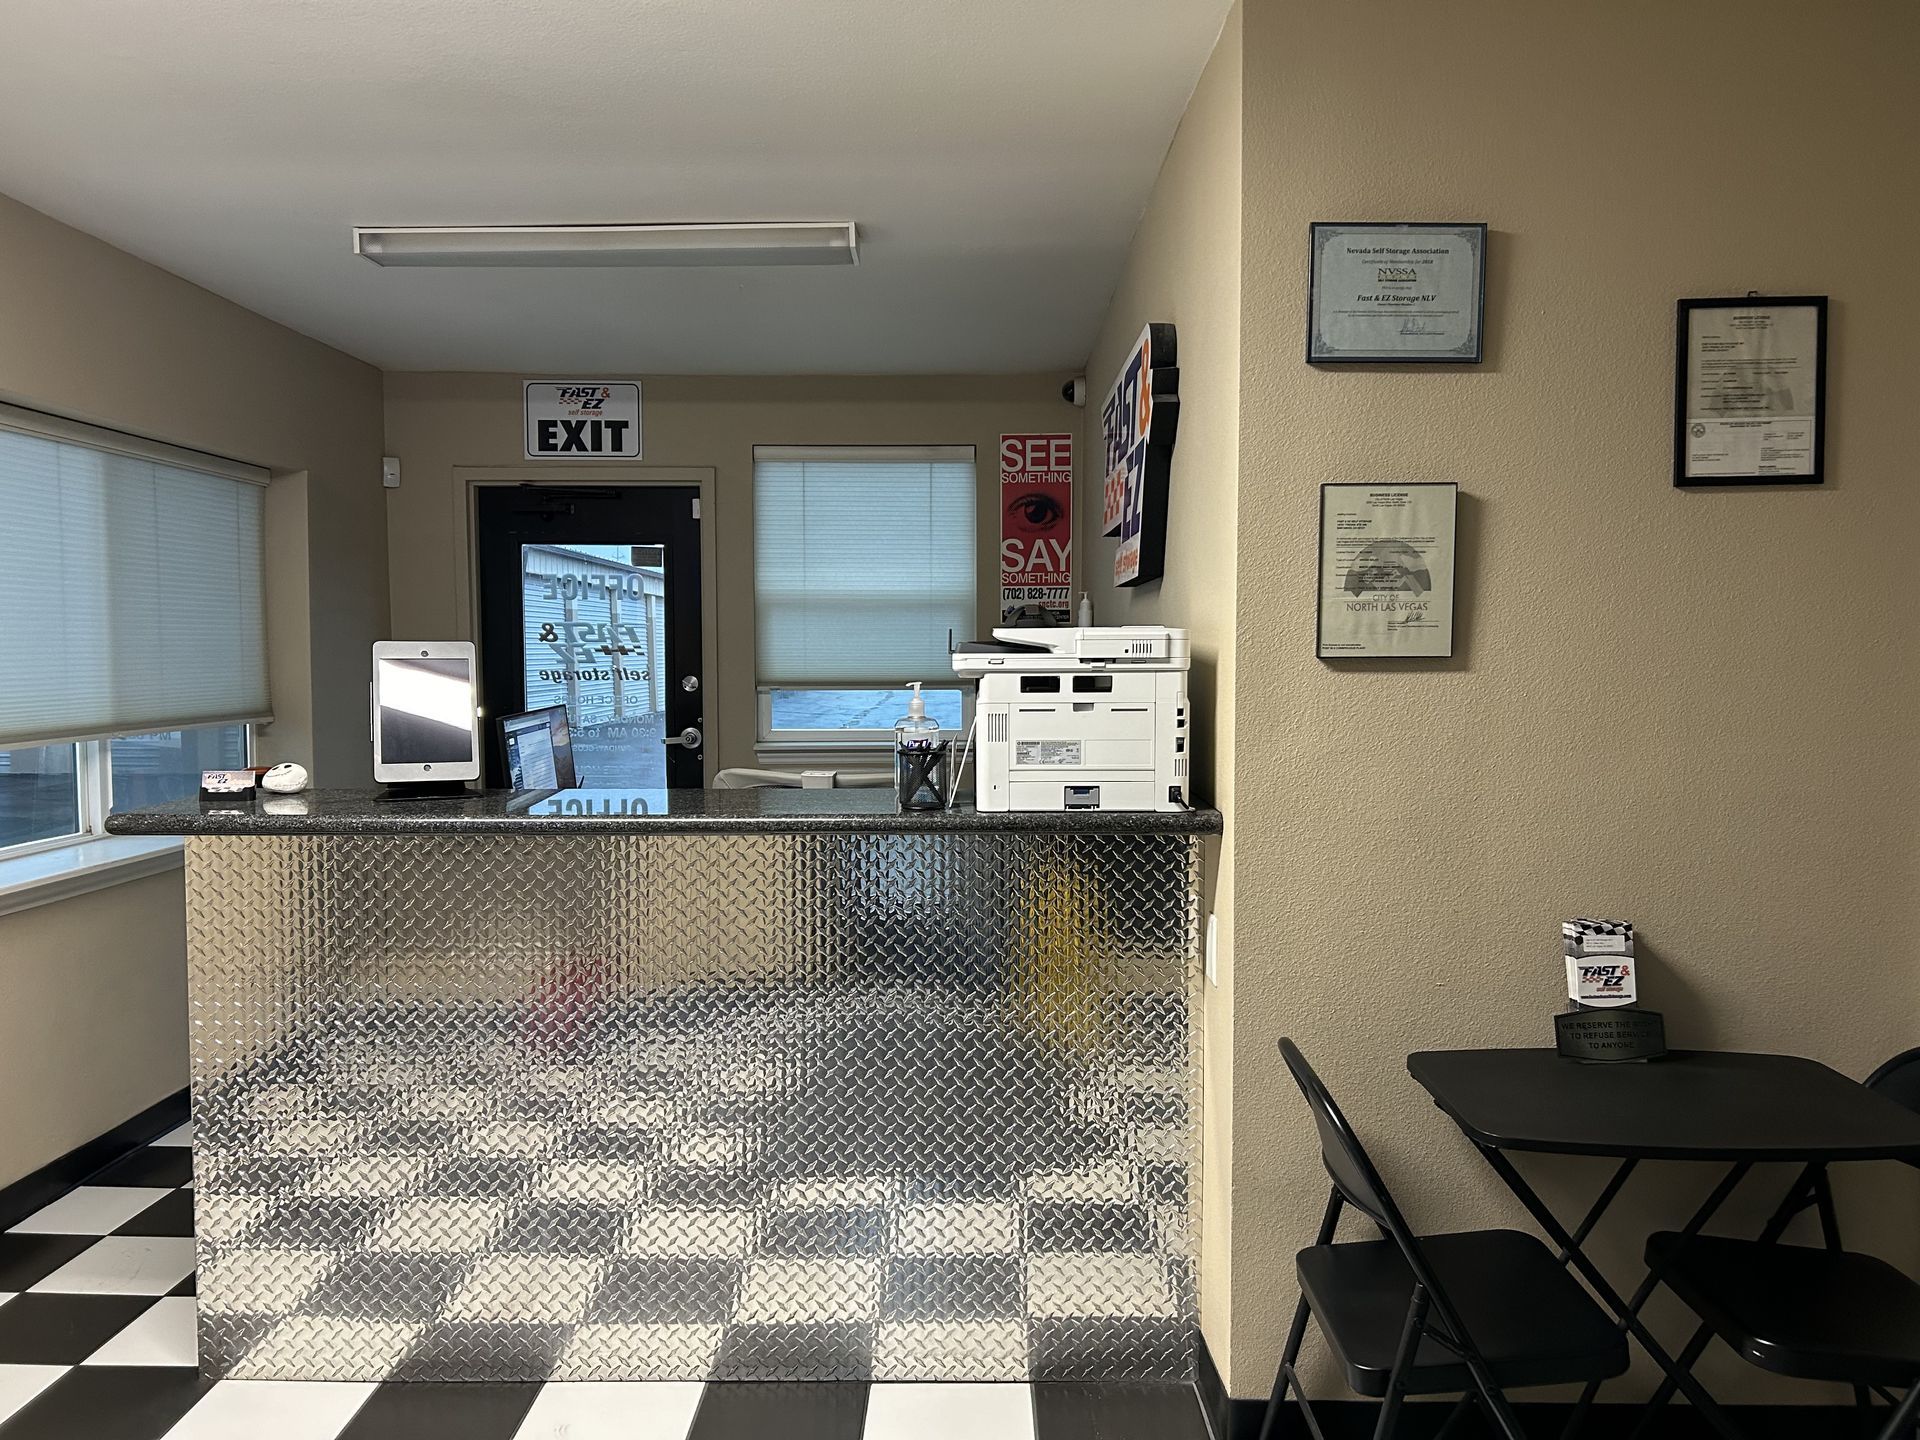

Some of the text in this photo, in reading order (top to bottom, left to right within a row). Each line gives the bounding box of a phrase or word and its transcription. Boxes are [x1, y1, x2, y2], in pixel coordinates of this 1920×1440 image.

[1386, 248, 1410, 256] Storage
[1392, 294, 1420, 303] Storage
[556, 387, 610, 398] FAST &
[581, 398, 604, 410] EZ
[1102, 338, 1151, 478] FAST &
[538, 420, 629, 452] EXIT
[1002, 439, 1072, 473] SEE
[1002, 472, 1071, 484] SOMETHING
[1122, 444, 1146, 544] EZ
[1002, 538, 1072, 572] SAY
[1002, 572, 1071, 584] SOMETHING
[1003, 588, 1070, 600] (702) 828-7777
[1346, 602, 1428, 612] NORTH LAS VEGAS
[1578, 965, 1630, 976] FAST &
[1603, 976, 1625, 986] EZ
